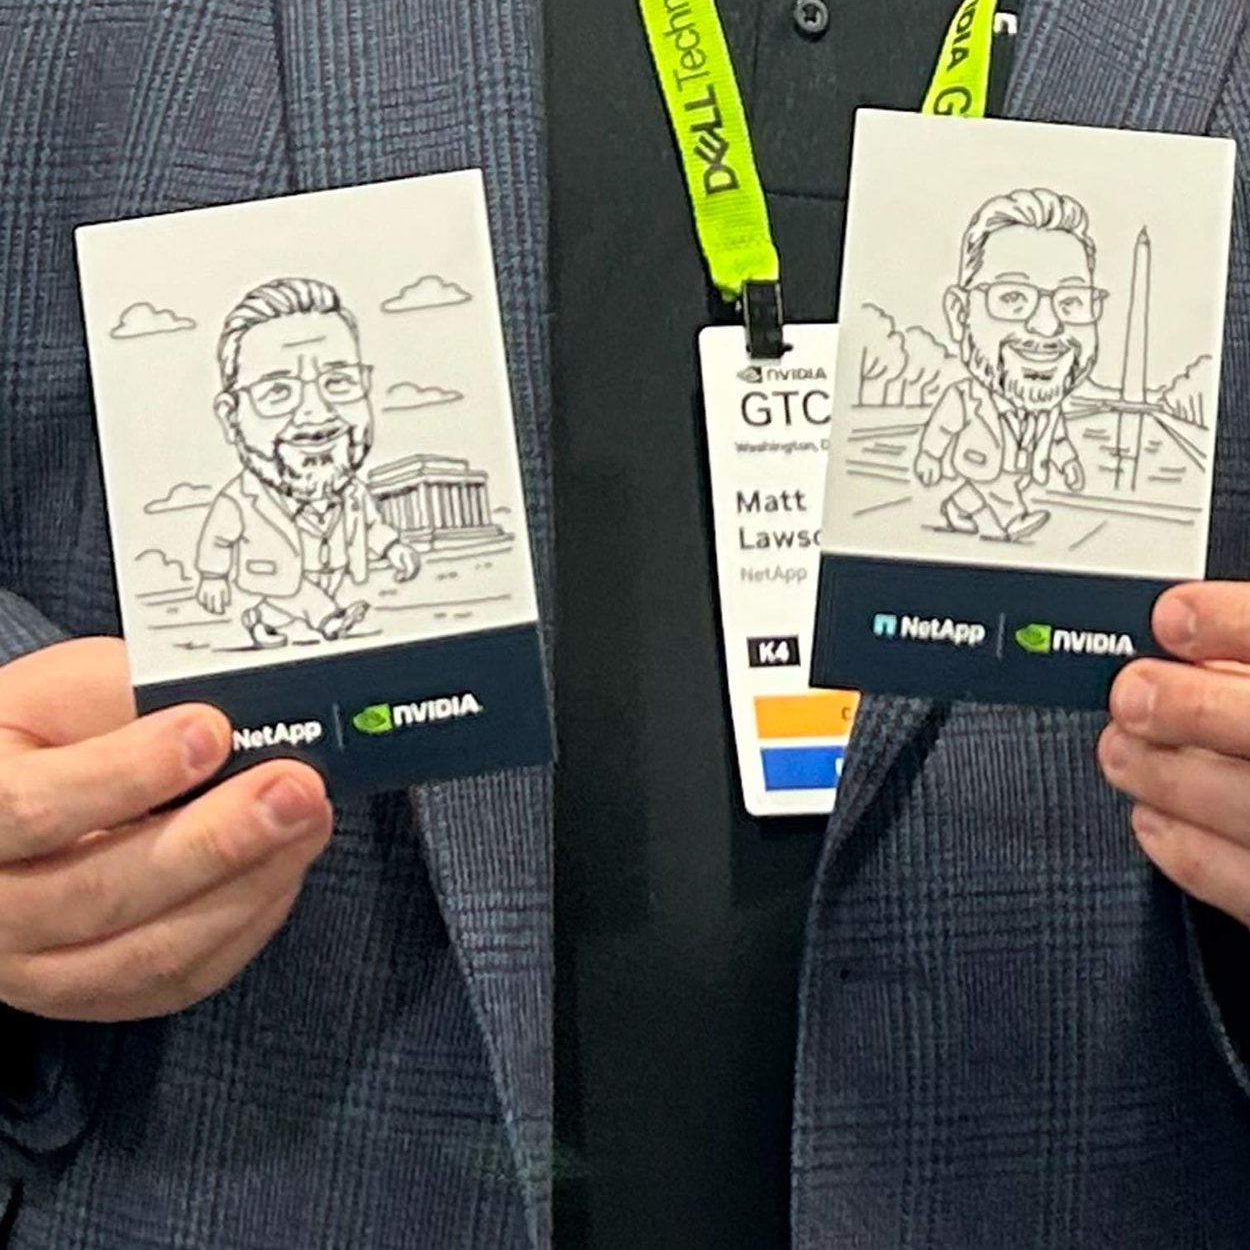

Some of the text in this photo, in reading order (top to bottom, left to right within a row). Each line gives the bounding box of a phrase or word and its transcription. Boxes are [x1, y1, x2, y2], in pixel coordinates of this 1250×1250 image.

[684, 82, 741, 195] DELL
[741, 389, 832, 427] GTC
[736, 489, 808, 513] Matt
[740, 565, 808, 584] NetApp
[900, 615, 986, 648] NetApp
[758, 640, 790, 664] K4
[232, 719, 323, 751] NetApp
